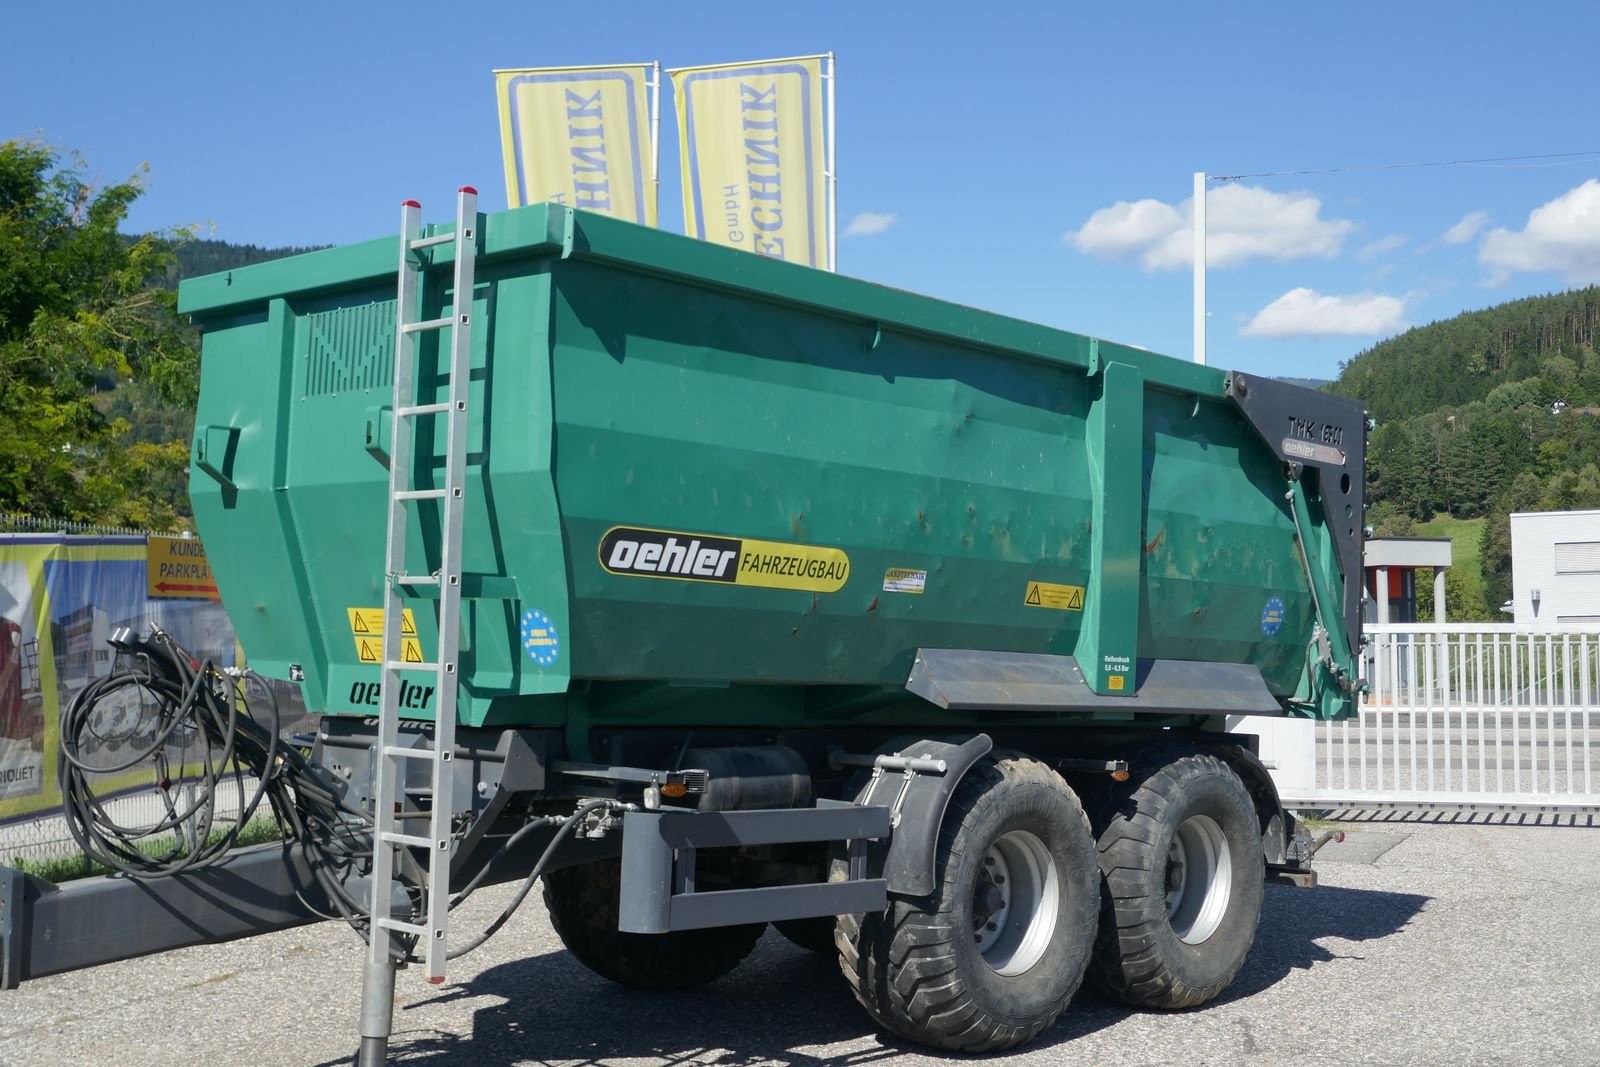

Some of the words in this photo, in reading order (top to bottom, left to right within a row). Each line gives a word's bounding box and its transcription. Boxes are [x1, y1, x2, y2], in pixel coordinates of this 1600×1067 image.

[1285, 442, 1315, 459] oehler
[608, 538, 736, 577] oehler
[741, 552, 847, 581] FAHRZEUGBAU
[160, 560, 211, 579] PARKPLÄ
[1104, 655, 1130, 663] Reifendruck
[1121, 664, 1130, 672] Bar
[349, 680, 434, 710] oeler
